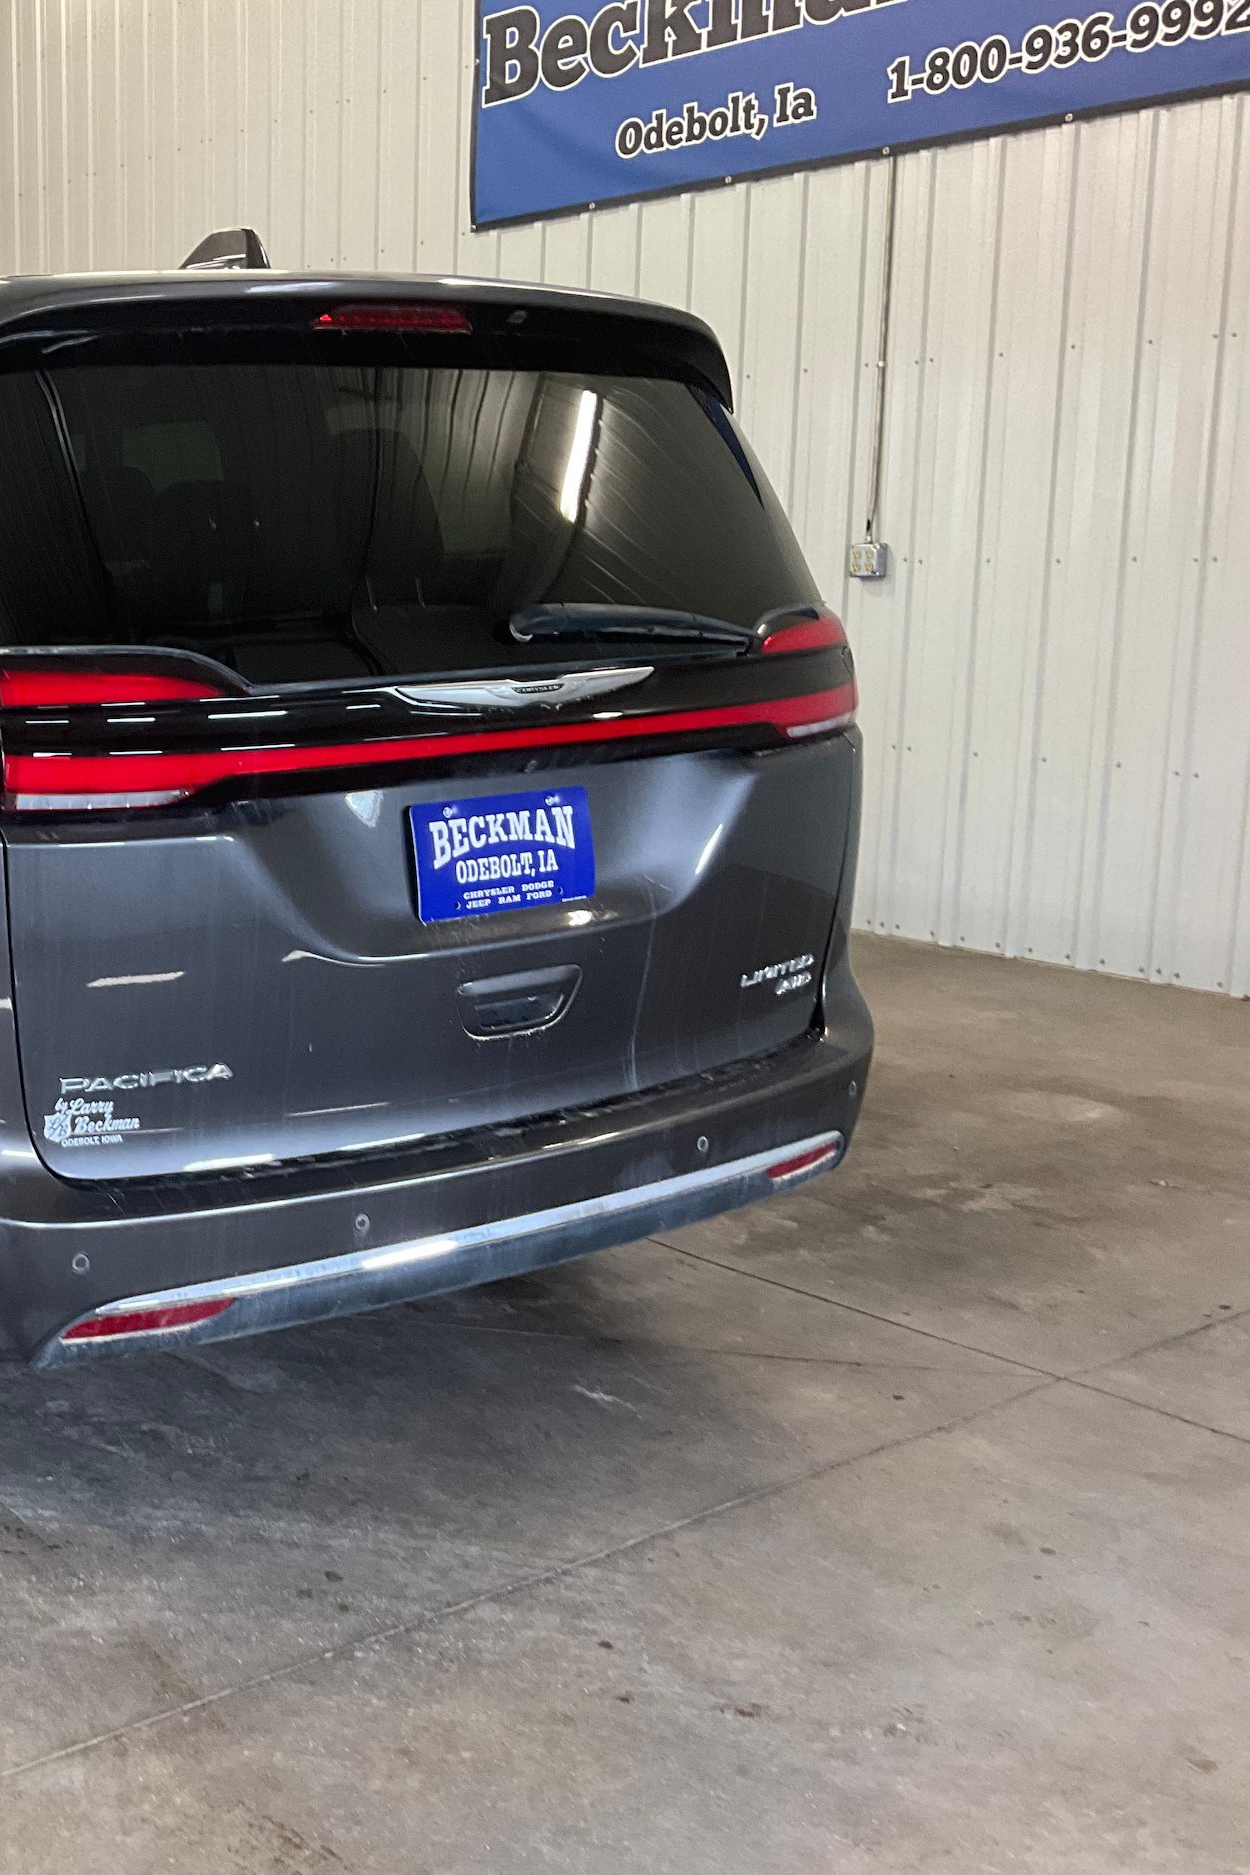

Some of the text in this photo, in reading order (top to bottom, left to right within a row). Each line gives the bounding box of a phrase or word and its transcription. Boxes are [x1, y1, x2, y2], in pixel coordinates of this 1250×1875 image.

[887, 0, 1250, 103] 1-800-936-9992
[615, 82, 817, 158] Odebolt, Ia
[429, 805, 576, 870] BECKMAN
[455, 849, 559, 884] ODEBOLT, IA
[463, 880, 555, 900] CHRYSLER DODGE
[465, 889, 553, 909] JEEP RAM FORD
[59, 1062, 234, 1094] PACIFICA
[55, 1097, 114, 1117] by Larry
[74, 1113, 140, 1133] Beckman
[61, 1134, 124, 1147] ODEBOLT, IOWA
